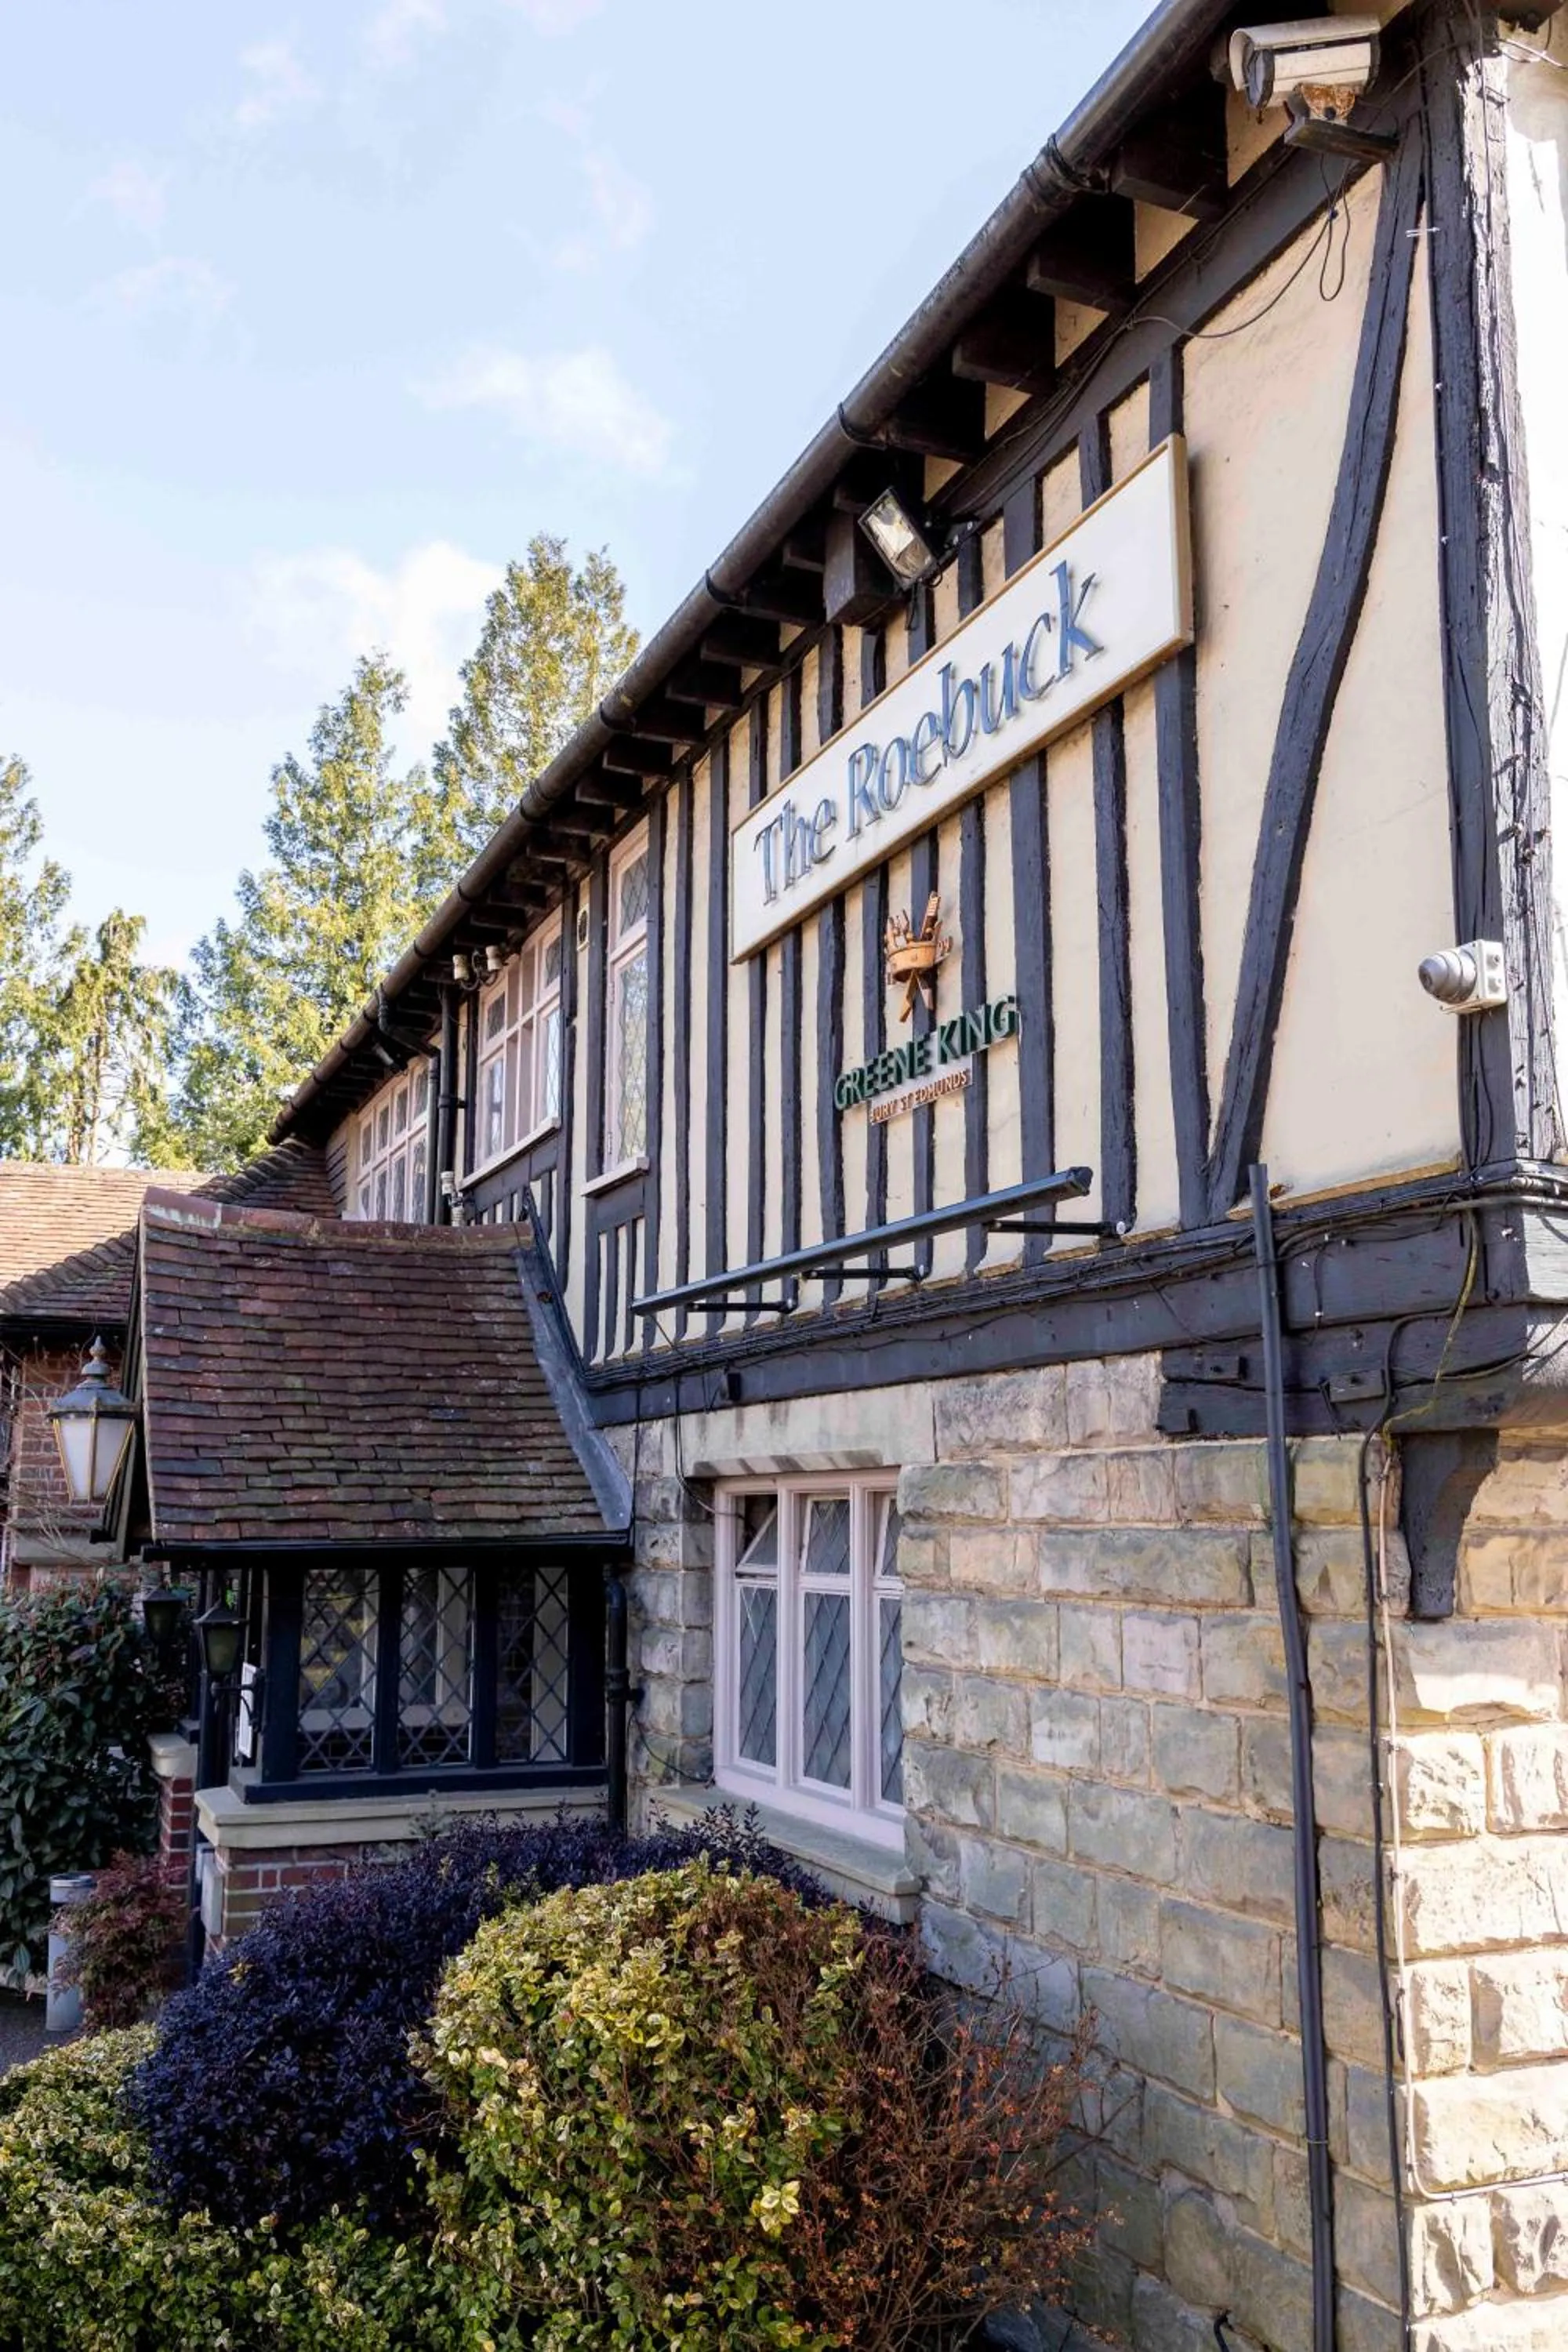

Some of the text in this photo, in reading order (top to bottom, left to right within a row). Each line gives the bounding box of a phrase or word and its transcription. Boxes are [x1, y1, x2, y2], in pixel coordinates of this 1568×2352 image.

[753, 559, 1104, 906] The Roebuck
[834, 995, 1019, 1110] GREENE KING
[915, 1068, 971, 1102] EDMUNDS
